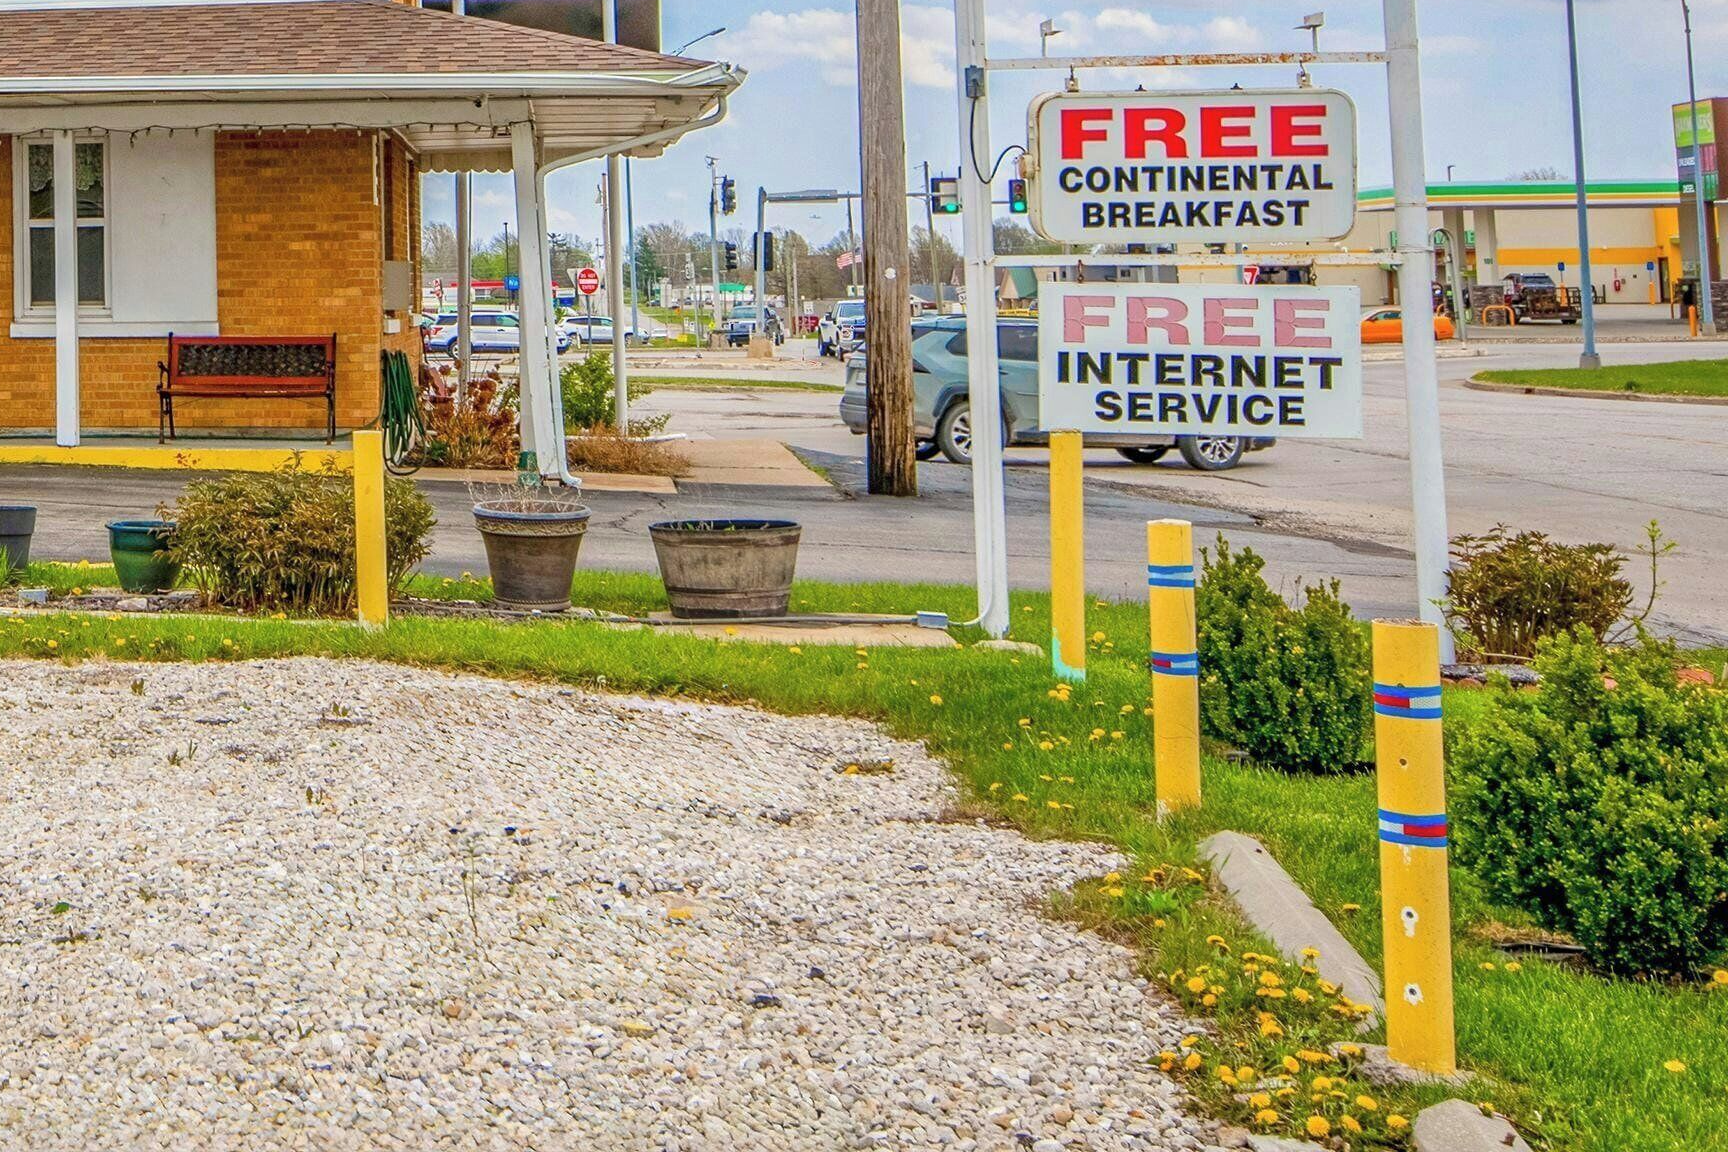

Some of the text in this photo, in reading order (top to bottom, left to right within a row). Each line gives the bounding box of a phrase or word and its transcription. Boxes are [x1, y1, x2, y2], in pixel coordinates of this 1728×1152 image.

[1060, 104, 1330, 161] FREE
[1058, 164, 1334, 193] CONTINENTAL
[1082, 199, 1310, 229] BREAKFAST
[1062, 295, 1333, 349] FREE
[1057, 351, 1343, 391] INTERNET
[1095, 391, 1306, 426] SERVICE
